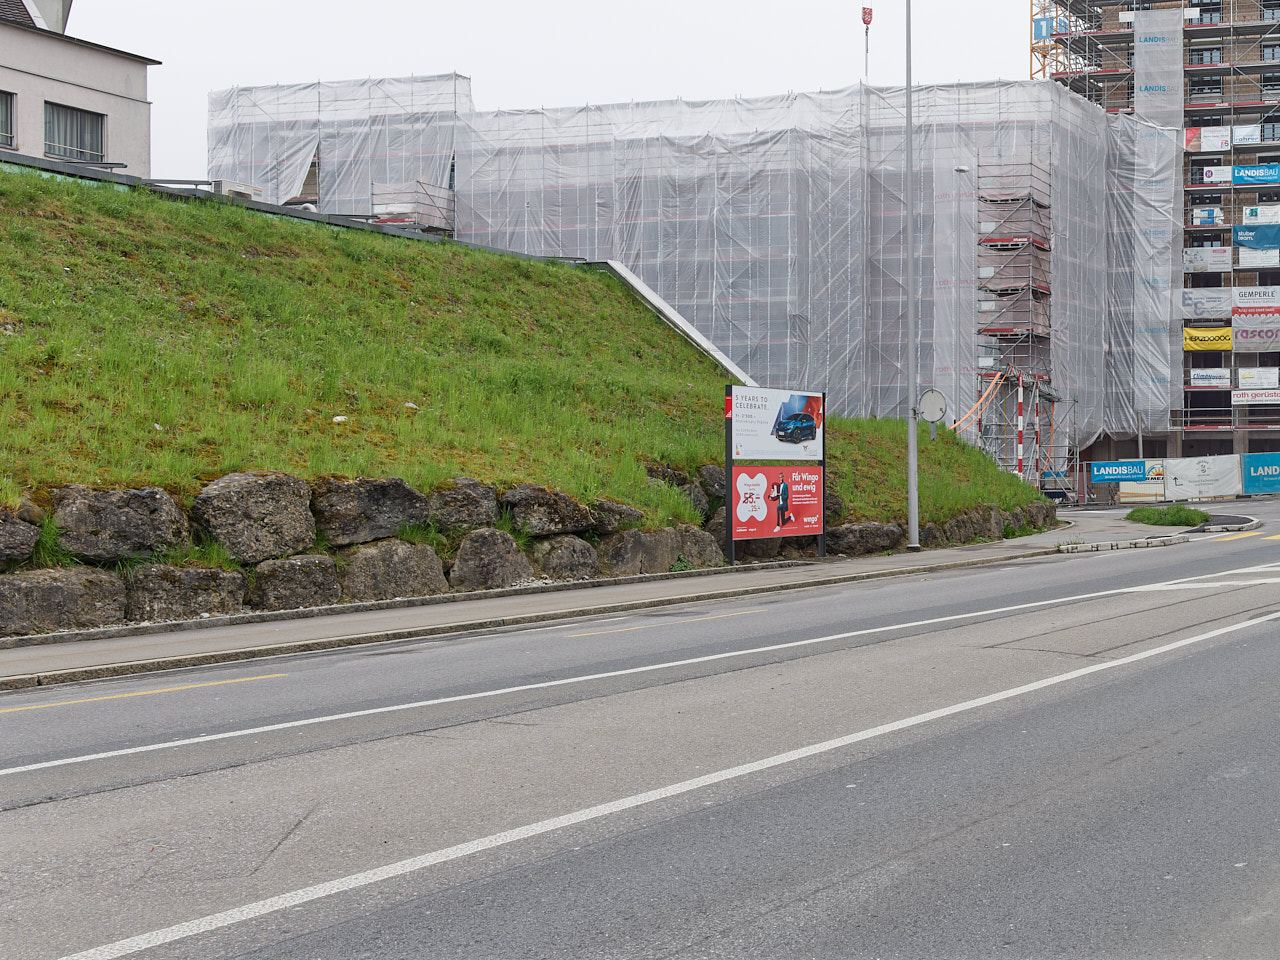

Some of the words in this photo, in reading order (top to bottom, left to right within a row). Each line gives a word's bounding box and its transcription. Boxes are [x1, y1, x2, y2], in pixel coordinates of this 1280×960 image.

[1234, 168, 1278, 176] LANDISBAU
[1235, 329, 1280, 339] rascor
[1094, 466, 1143, 474] LANDISBAU
[802, 473, 818, 482] Wingo
[792, 482, 802, 491] und
[804, 484, 816, 492] ewig
